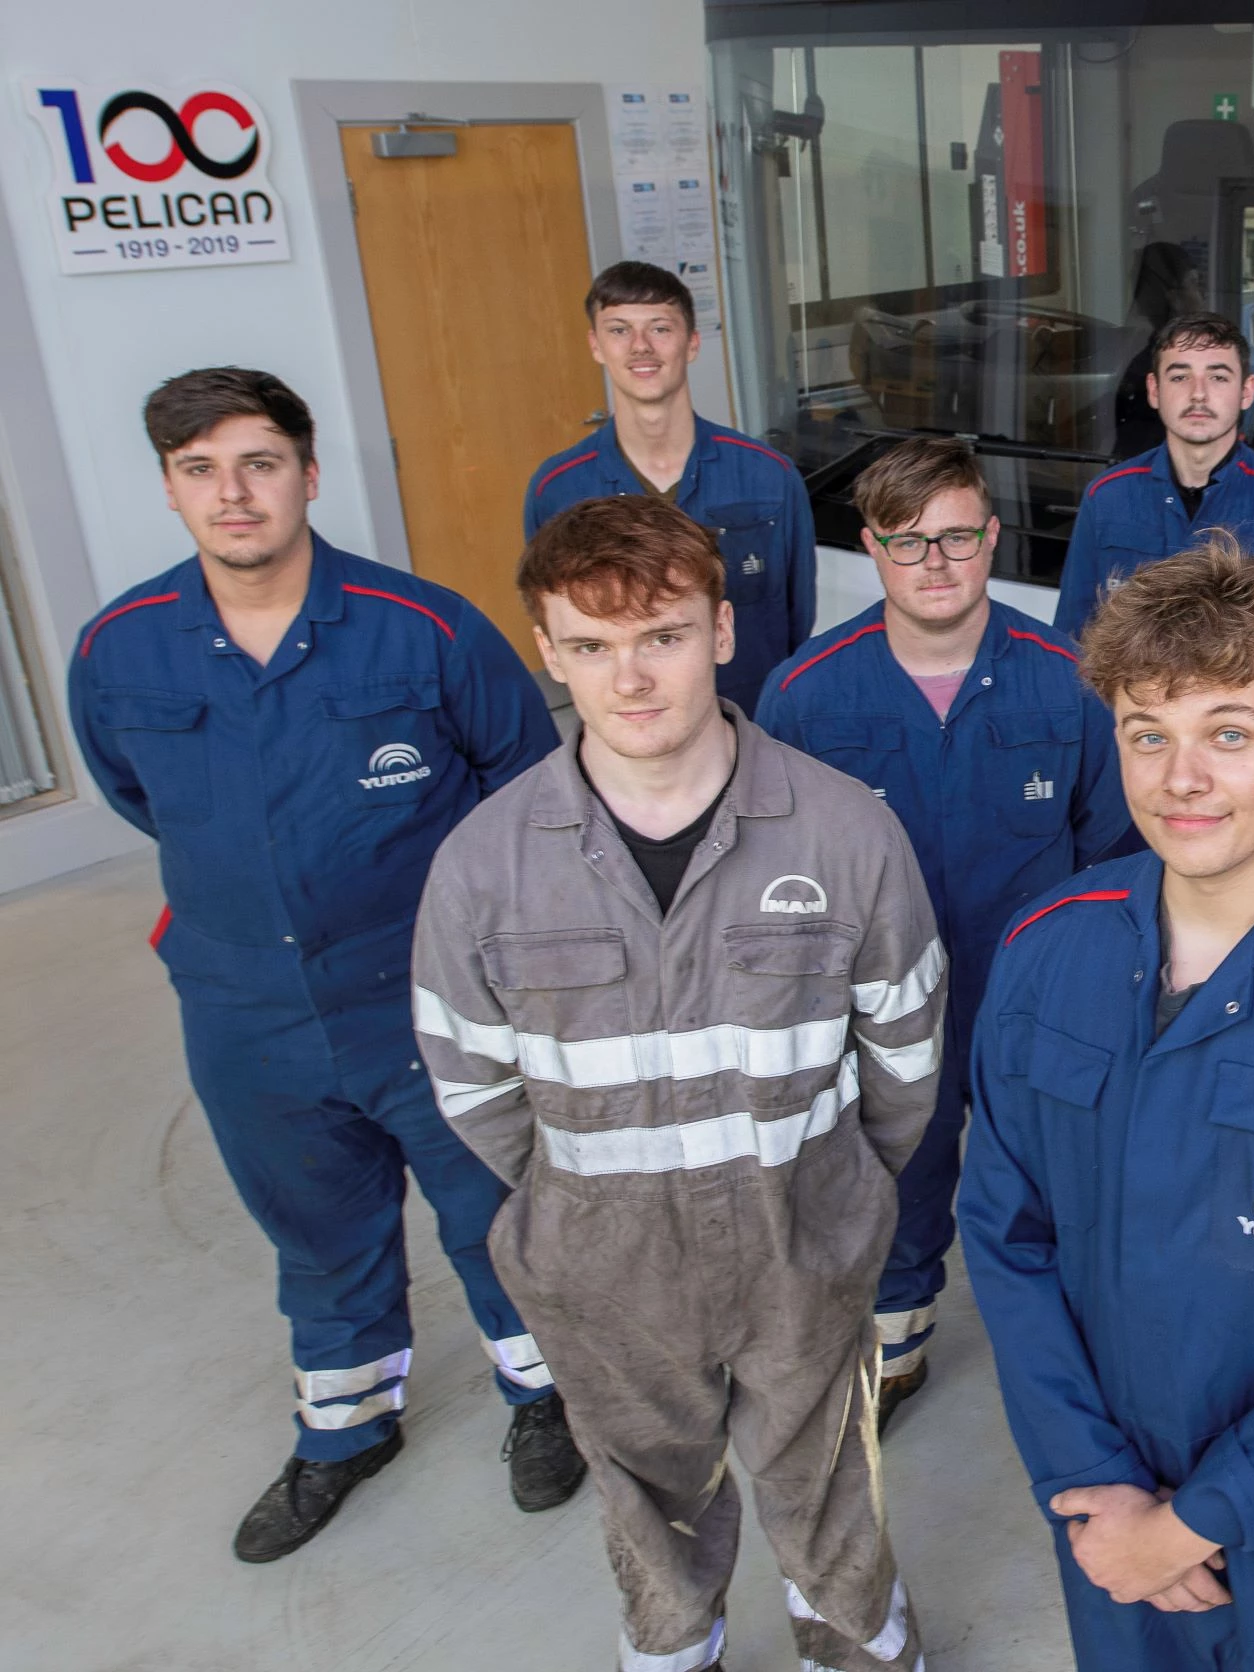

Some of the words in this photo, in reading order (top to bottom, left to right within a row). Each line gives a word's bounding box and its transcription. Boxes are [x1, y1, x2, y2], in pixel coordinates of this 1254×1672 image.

[37, 88, 260, 184] 100
[61, 190, 273, 232] PELICAN
[1012, 199, 1027, 276] .co.uk
[357, 766, 432, 790] YUTONG
